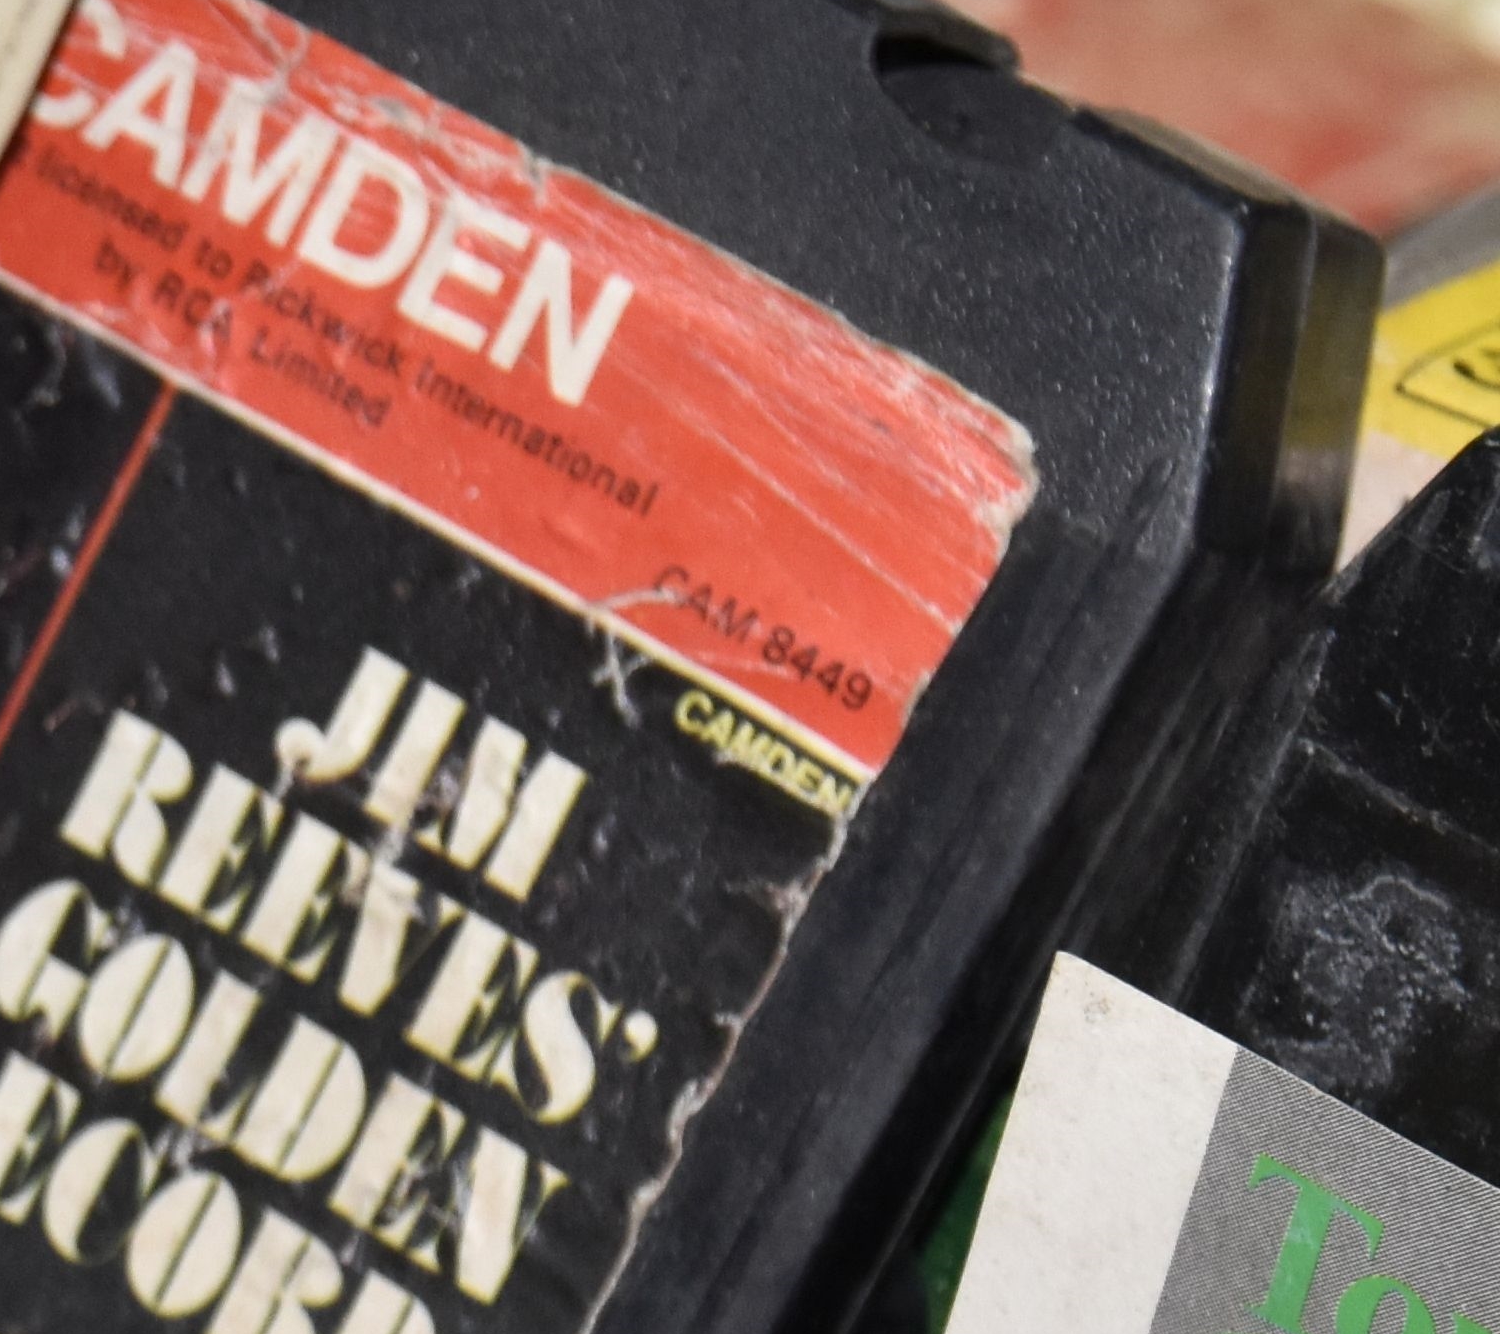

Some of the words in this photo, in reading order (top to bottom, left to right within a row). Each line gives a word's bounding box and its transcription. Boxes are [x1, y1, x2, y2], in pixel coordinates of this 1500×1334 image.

[152, 268, 232, 344] RCA
[249, 326, 391, 428] Limited
[195, 238, 233, 280] to
[416, 359, 658, 516] International
[652, 566, 758, 643] CAM
[761, 629, 874, 709] 8449
[274, 643, 587, 904] JIM
[674, 690, 856, 817] CAMDEN
